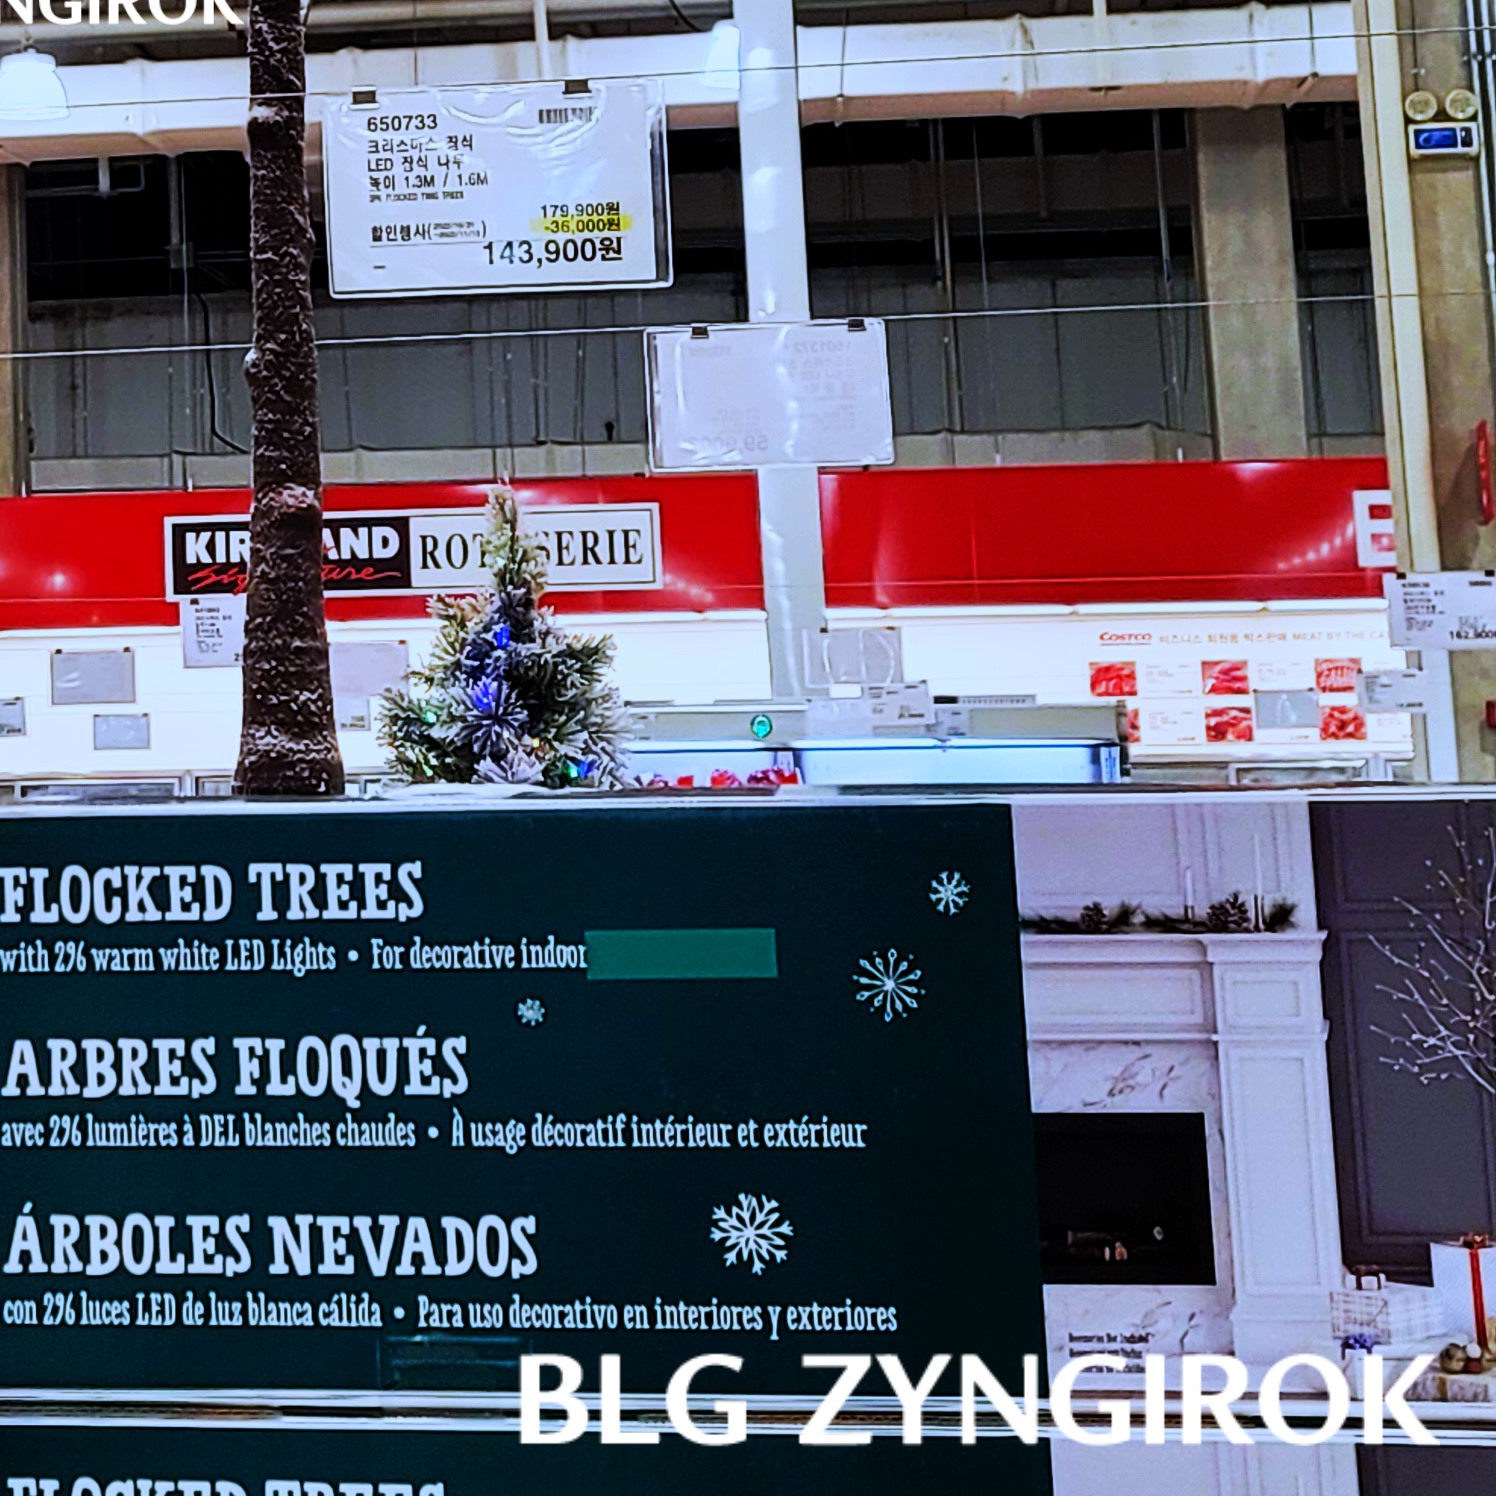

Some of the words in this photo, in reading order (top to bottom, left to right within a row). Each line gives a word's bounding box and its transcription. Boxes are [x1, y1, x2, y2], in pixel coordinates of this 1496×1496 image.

[367, 113, 438, 132] 650733
[367, 158, 394, 172] LED
[404, 174, 436, 189] 1.3M
[457, 171, 489, 187] 1.6M
[540, 201, 620, 220] 179,900원
[544, 217, 621, 235] -36,000원
[483, 236, 623, 269] 143,900원
[185, 525, 401, 565] KIRAND
[248, 860, 424, 923] TREES
[54, 940, 87, 973] 296
[90, 947, 155, 972] warm
[158, 937, 220, 971] white
[224, 938, 265, 971] LED
[270, 937, 337, 978] Lights
[370, 938, 406, 970] For
[409, 935, 515, 969] decorative
[0, 1035, 217, 1099] ARBRES
[232, 1024, 469, 1111] FLOQUÉS
[1, 1122, 45, 1147] avec
[49, 1114, 82, 1147] 296
[85, 1112, 179, 1147] lumières
[182, 1113, 195, 1147] à
[199, 1113, 240, 1147] DEL
[243, 1112, 332, 1147] blanches
[335, 1112, 416, 1147] chaudes
[451, 1107, 465, 1147] À
[470, 1119, 526, 1155] usage
[531, 1112, 627, 1148] décoratif
[630, 1114, 733, 1148] intérieur
[737, 1118, 760, 1148] et
[763, 1115, 868, 1148] extérieur
[2, 1201, 252, 1278] ÁRBOLES
[267, 1214, 538, 1280] NEVADOS
[2, 1299, 39, 1325] con
[42, 1291, 76, 1326] 296
[79, 1291, 131, 1326] luces
[135, 1292, 176, 1326] LED
[182, 1291, 205, 1326] de
[208, 1291, 243, 1326] luz
[246, 1291, 315, 1327] blanca
[318, 1292, 383, 1327] cálida
[417, 1294, 465, 1328] Para
[468, 1302, 504, 1329] uso
[508, 1293, 618, 1330] decorativo
[623, 1304, 650, 1330] en
[654, 1296, 763, 1331] interiores
[767, 1305, 782, 1341] y
[786, 1298, 898, 1332] exteriores
